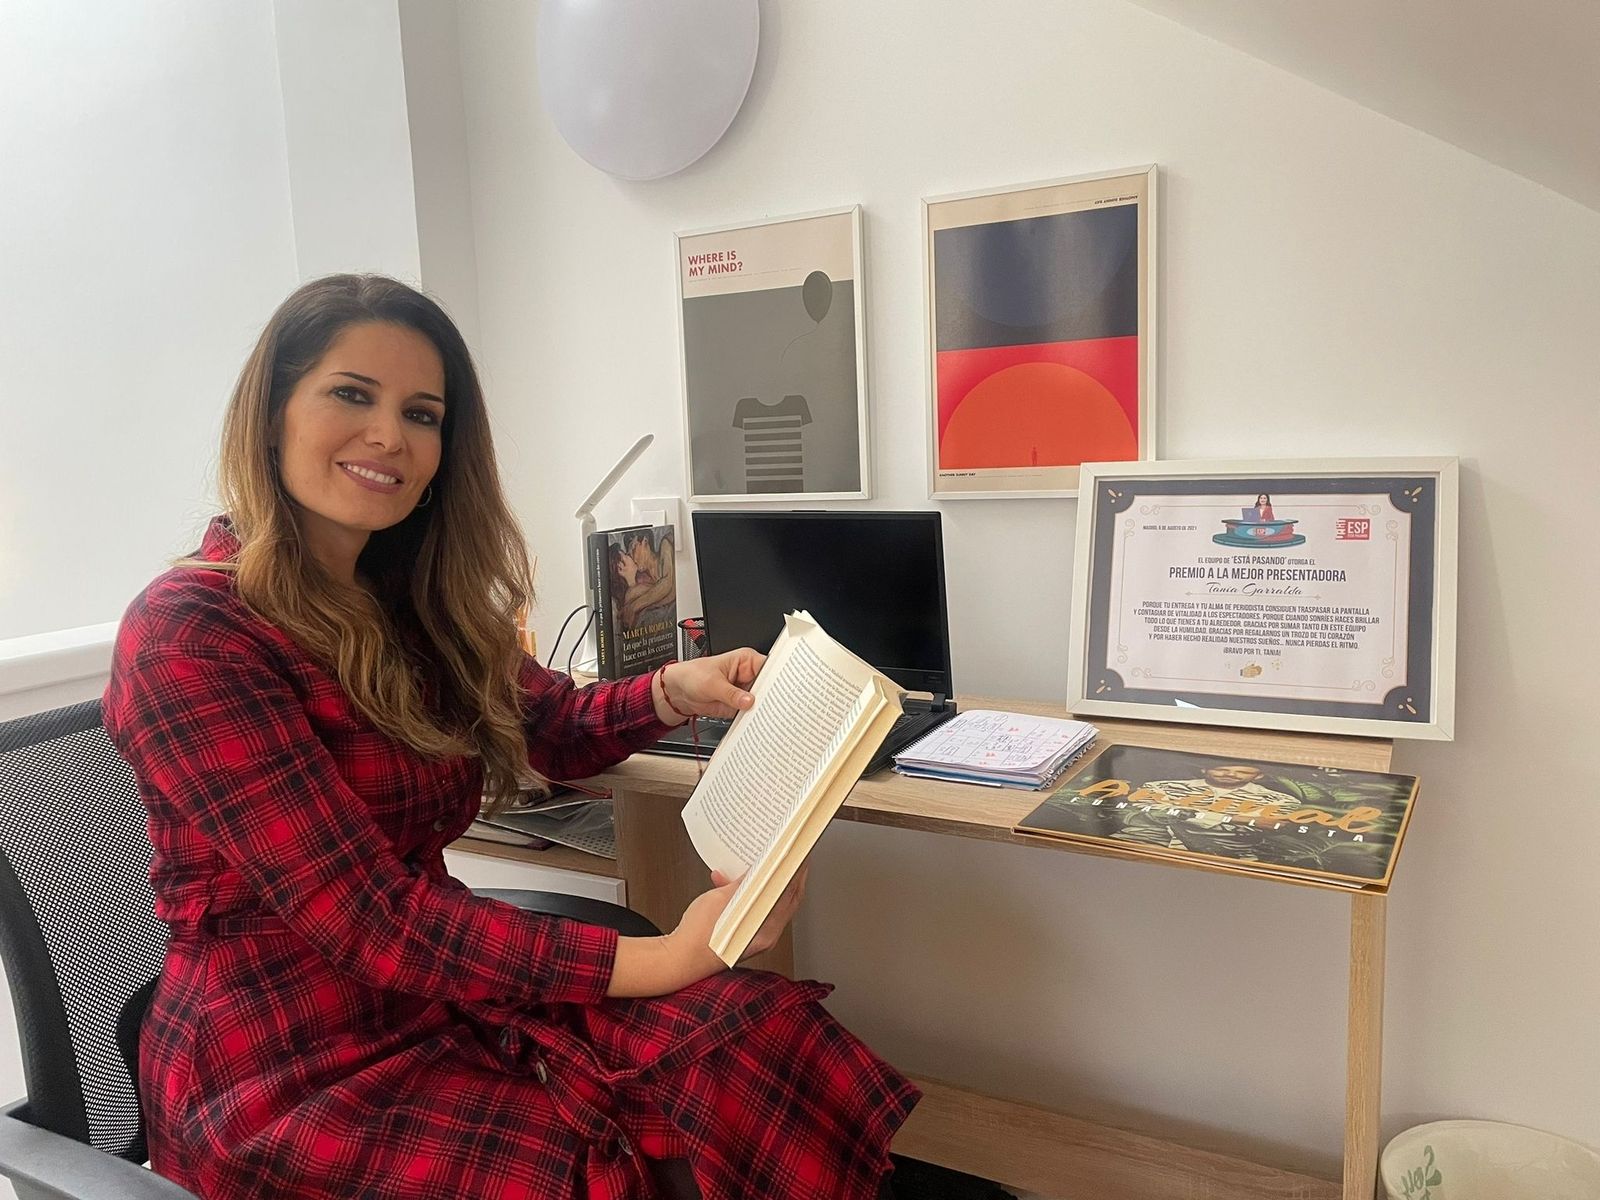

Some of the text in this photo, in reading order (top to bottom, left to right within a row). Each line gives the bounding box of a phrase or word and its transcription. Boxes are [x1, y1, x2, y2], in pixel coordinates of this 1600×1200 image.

[688, 250, 736, 265] WHERE IS
[689, 266, 705, 277] MY
[708, 262, 743, 274] MIND?
[1348, 522, 1368, 534] ESP
[1169, 567, 1346, 582] PREMIO A LA MEJOR PRESENTADORA
[1206, 582, 1302, 596] Tania Garralda
[1298, 606, 1331, 614] TRASPASAR
[623, 627, 648, 639] MARTA
[1245, 629, 1280, 637] REGALARNOS
[632, 641, 642, 650] que
[624, 653, 637, 662] hace
[1070, 796, 1364, 842] FUNAMBULISTA
